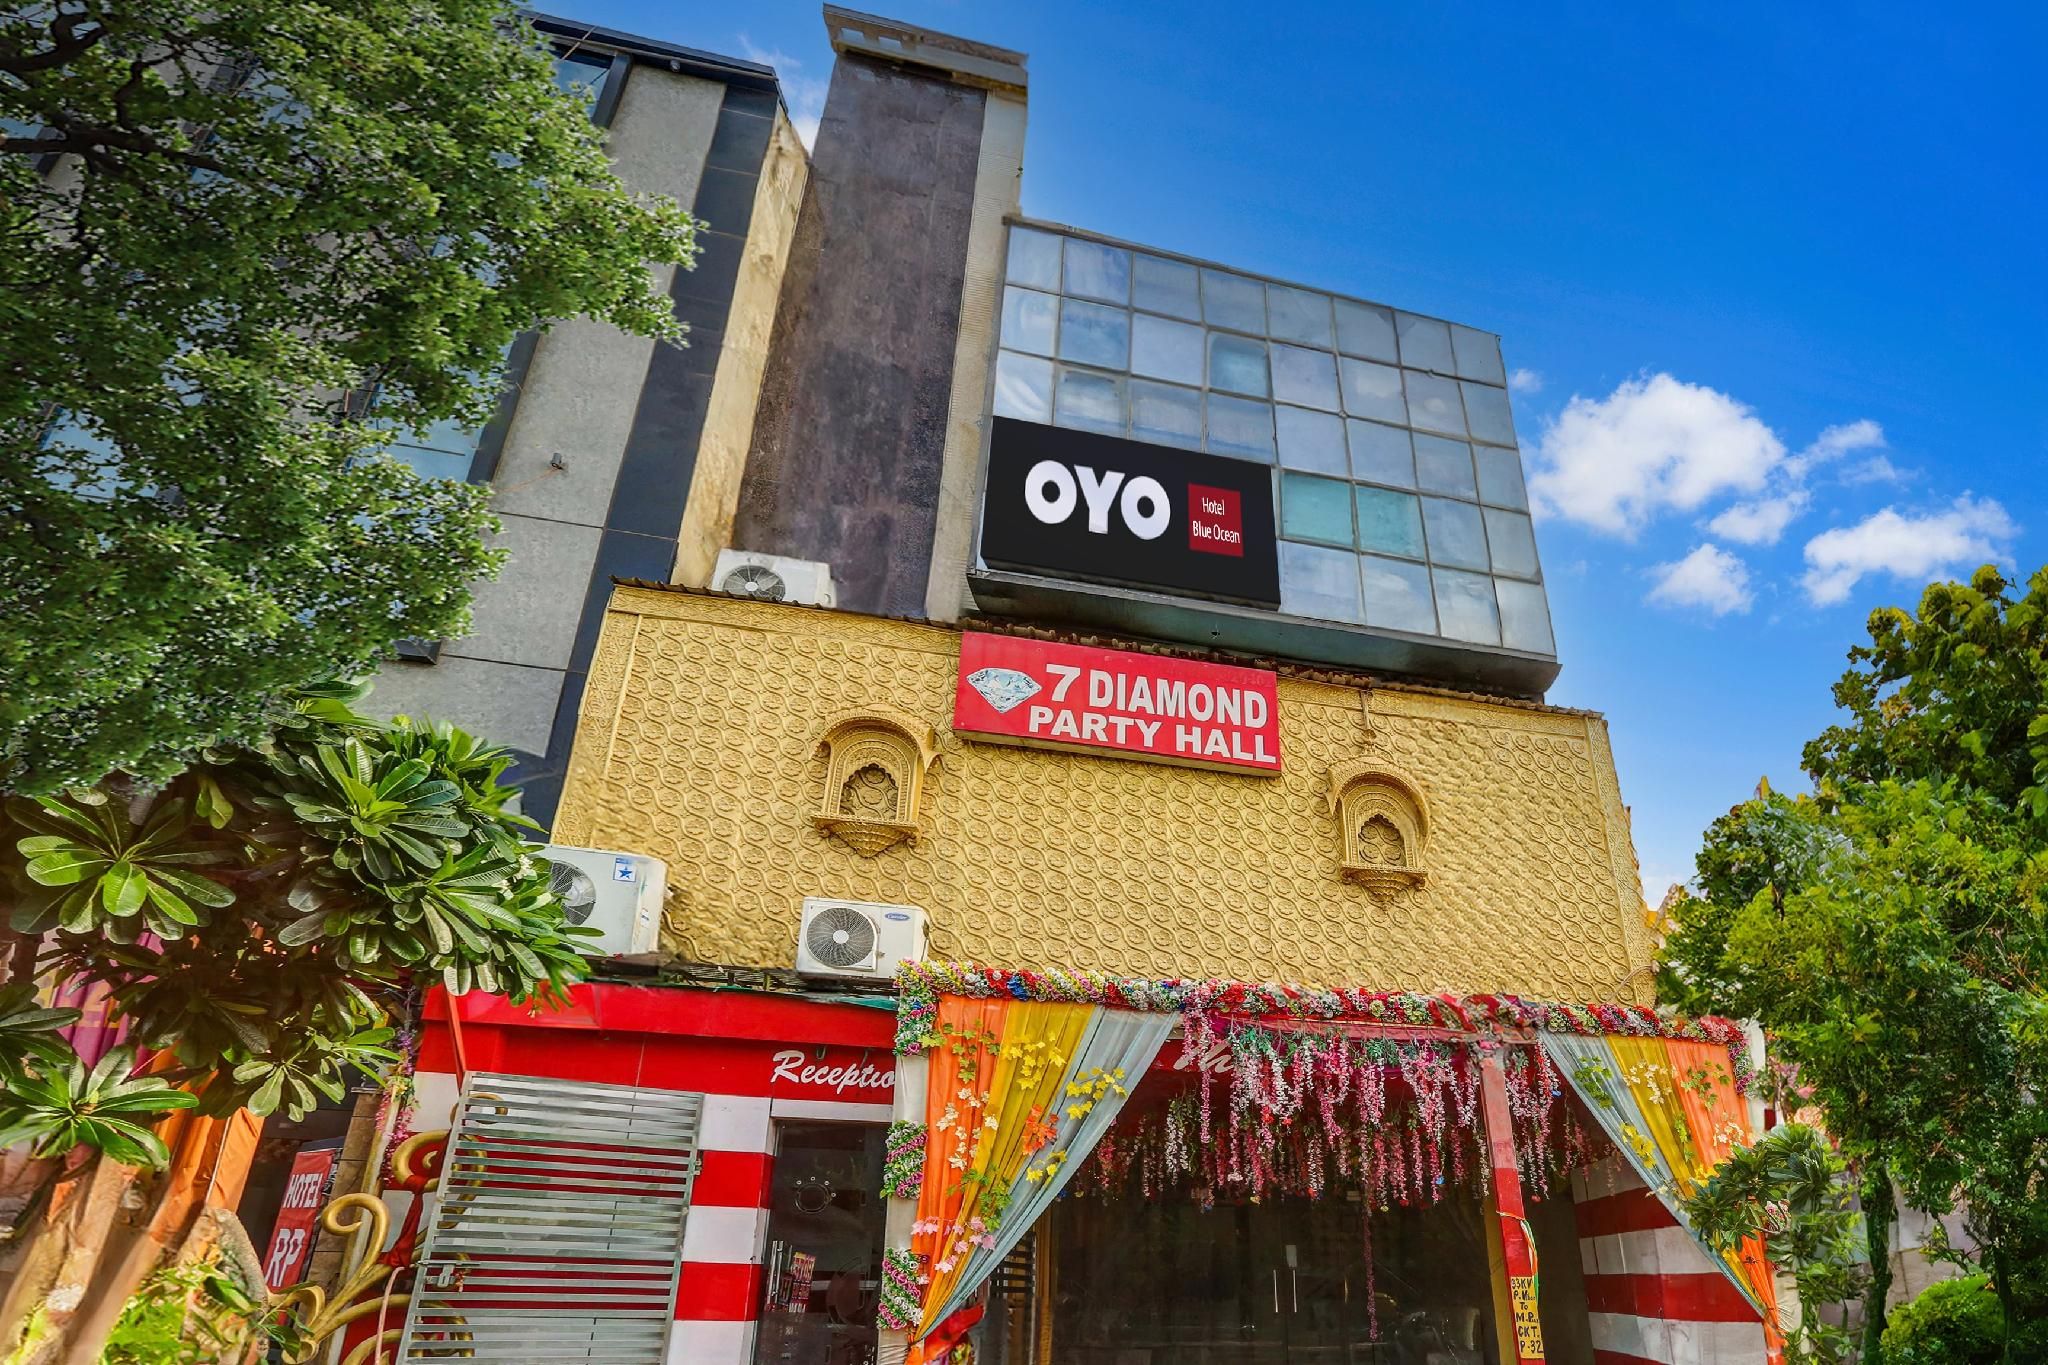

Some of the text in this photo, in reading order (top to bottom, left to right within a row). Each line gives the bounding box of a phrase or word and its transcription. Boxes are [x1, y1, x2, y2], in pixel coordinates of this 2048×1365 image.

[1025, 460, 1171, 540] OYO
[1202, 497, 1225, 516] Hotel
[1192, 520, 1240, 544] Blue Ocean
[1045, 663, 1081, 702] 7
[1088, 669, 1269, 729] DIAMOND
[1028, 705, 1277, 763] PARTY HALL
[770, 1050, 895, 1094] Receptio
[283, 1173, 324, 1208] HOTEL
[265, 1228, 306, 1287] RP
[1519, 1302, 1529, 1310] To
